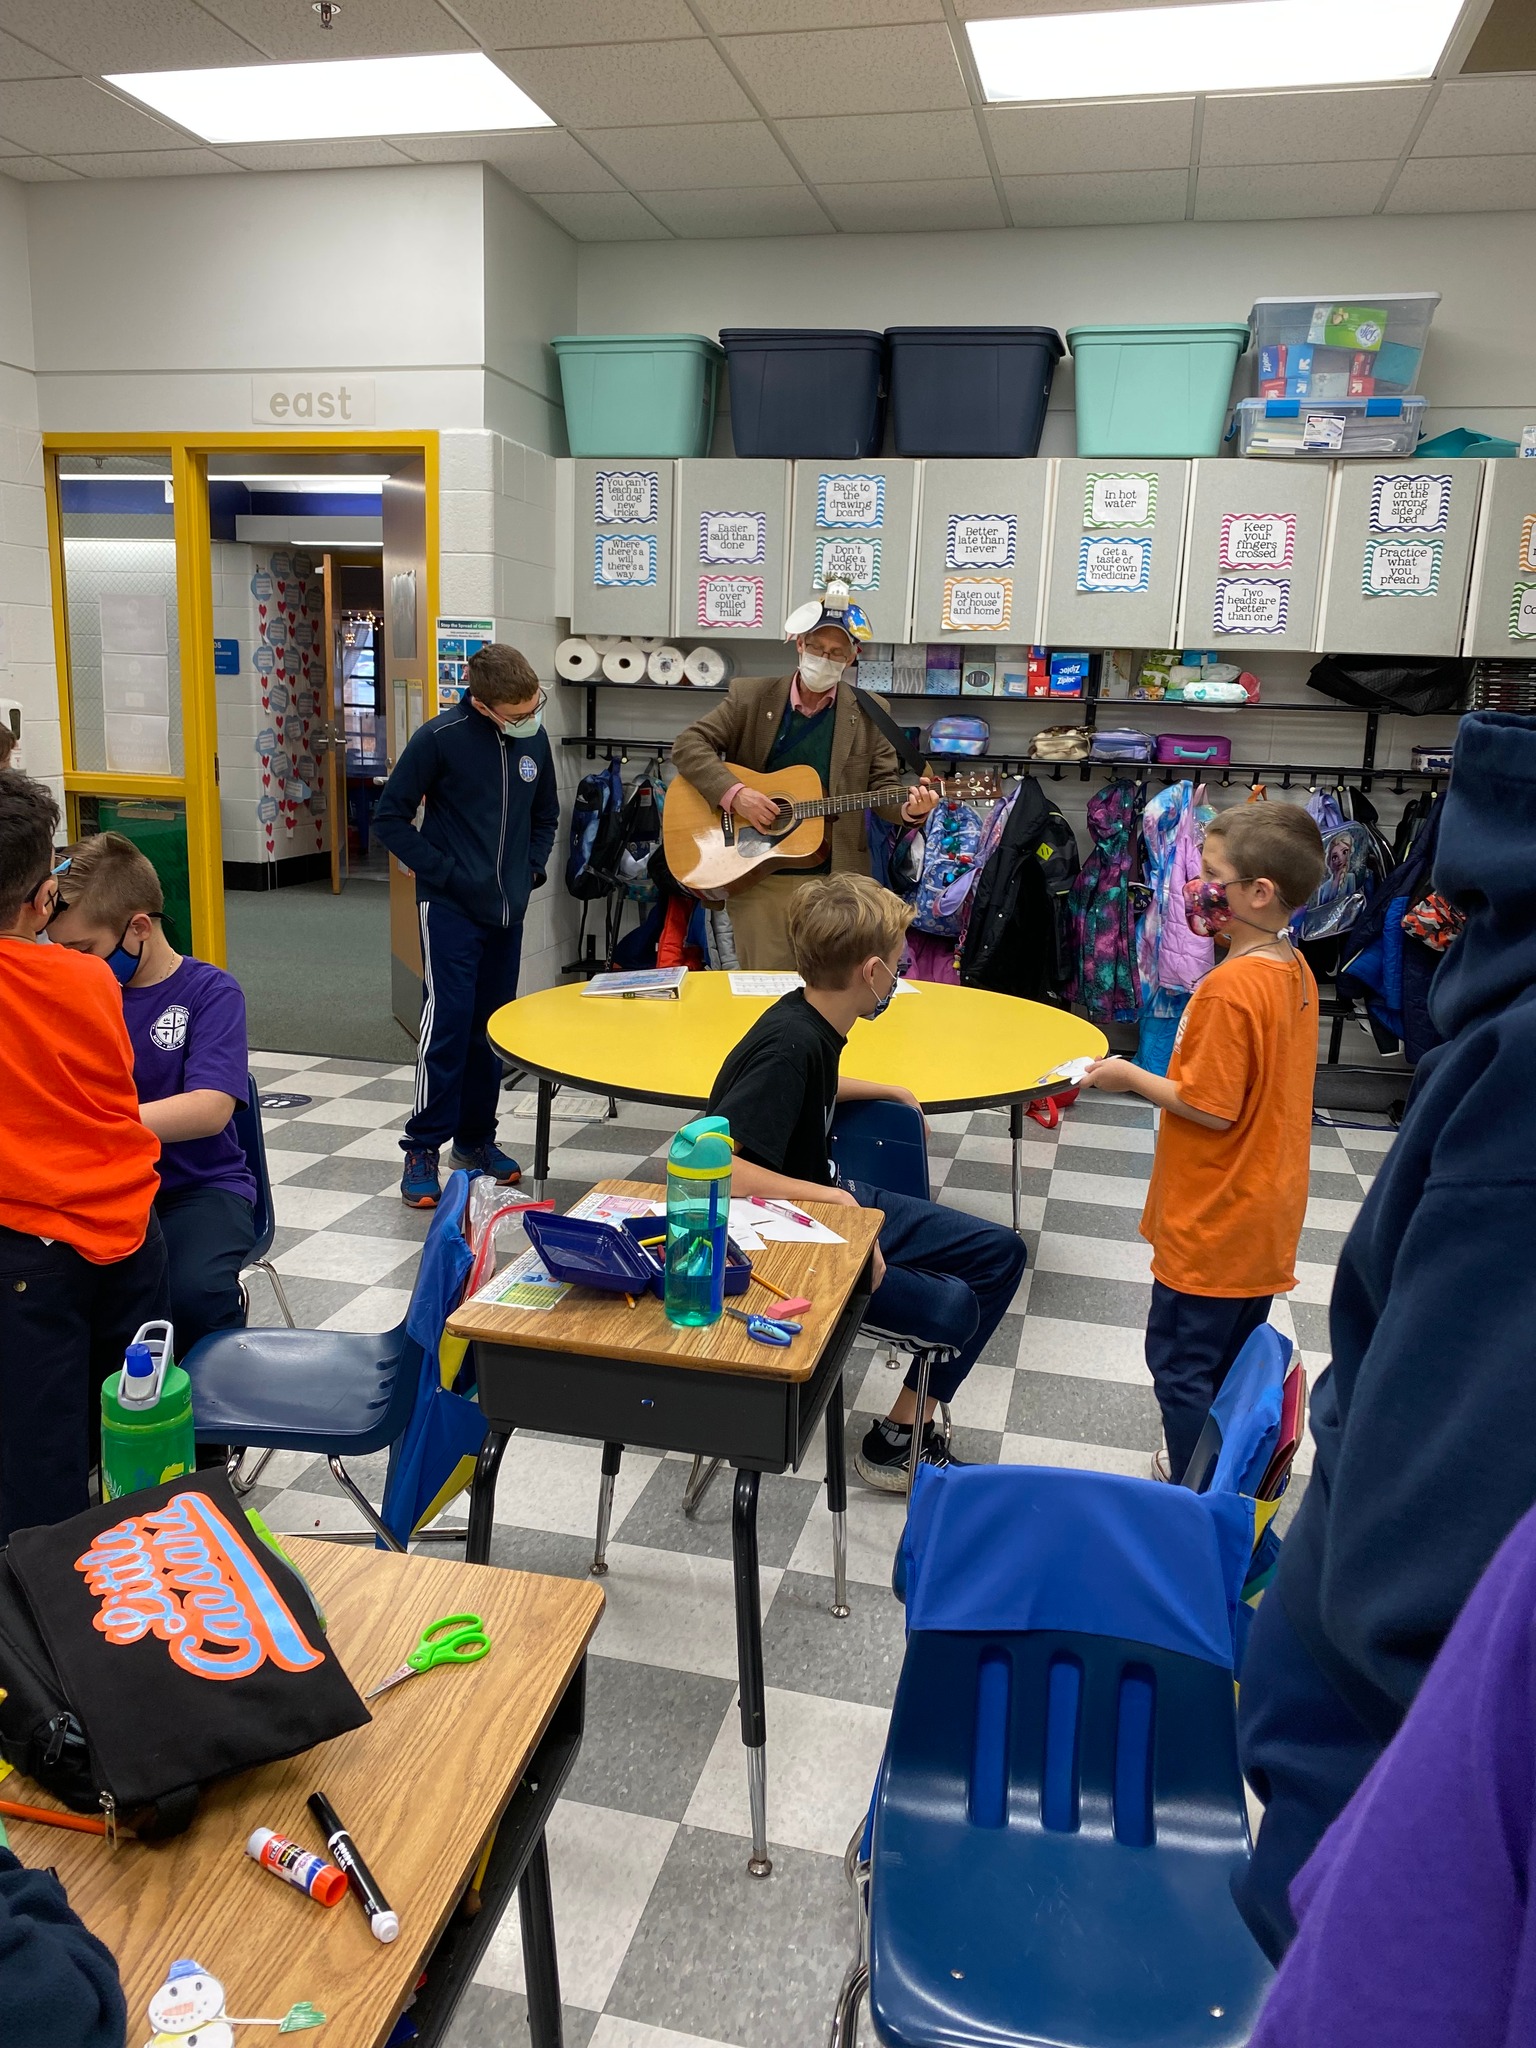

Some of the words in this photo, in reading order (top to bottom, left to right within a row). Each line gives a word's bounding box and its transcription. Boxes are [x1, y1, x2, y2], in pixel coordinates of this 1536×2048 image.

[1262, 352, 1271, 373] Ziploc
[269, 386, 352, 420] east
[607, 478, 624, 487] You
[625, 478, 648, 487] can't
[833, 482, 858, 492] Back
[860, 483, 871, 492] to
[1394, 481, 1413, 490] Get
[1415, 482, 1430, 492] up
[608, 486, 632, 494] teach
[1104, 490, 1116, 499] In
[1118, 489, 1138, 499] hot
[1410, 489, 1429, 498] the
[611, 493, 625, 502] old
[626, 493, 642, 503] dog
[843, 491, 860, 500] the
[617, 501, 636, 509] new
[829, 499, 872, 511] drawing
[1104, 499, 1138, 508] water
[1392, 499, 1429, 509] wrong
[836, 508, 865, 517] board
[1391, 506, 1413, 515] side
[1415, 507, 1426, 516] of
[1398, 514, 1418, 524] bed
[718, 523, 749, 533] Easier
[965, 526, 999, 536] Better
[1243, 522, 1273, 534] Keep
[710, 532, 729, 541] said
[731, 532, 756, 541] than
[957, 535, 979, 545] late
[980, 535, 1005, 545] than
[1244, 532, 1272, 541] your
[612, 539, 641, 548] Where
[720, 540, 745, 549] done
[965, 544, 998, 553] never
[1236, 540, 1278, 551] fingers
[607, 547, 637, 556] there's
[835, 545, 862, 555] Don't
[1102, 547, 1120, 556] Get
[1235, 549, 1277, 558] crossed
[1379, 548, 1428, 557] Practice
[618, 555, 634, 563] will
[831, 553, 859, 565] judge
[1096, 555, 1121, 564] taste
[1122, 555, 1134, 564] of
[1387, 556, 1417, 566] what
[607, 562, 637, 571] there's
[828, 561, 852, 571] book
[854, 561, 868, 573] by
[1090, 564, 1114, 574] your
[1116, 564, 1138, 572] own
[840, 571, 869, 580] cover
[1091, 571, 1137, 580] medicine
[1390, 567, 1412, 577] you
[1380, 575, 1420, 586] preach
[708, 583, 735, 592] Don't
[736, 585, 754, 595] cry
[1242, 588, 1264, 597] Two
[719, 592, 743, 600] over
[954, 590, 982, 599] Eaten
[984, 590, 1002, 599] out
[714, 600, 746, 610] spilled
[957, 597, 969, 606] of
[969, 598, 998, 607] house
[1227, 595, 1257, 605] heads
[1258, 597, 1277, 605] are
[719, 608, 742, 617] milk
[953, 606, 972, 615] and
[974, 606, 1001, 615] home
[1235, 604, 1267, 613] better
[1227, 611, 1252, 621] than
[1253, 613, 1273, 621] one
[1060, 664, 1081, 675] Ziploc
[1056, 676, 1076, 685] Ziploc
[78, 1518, 187, 1641] Little
